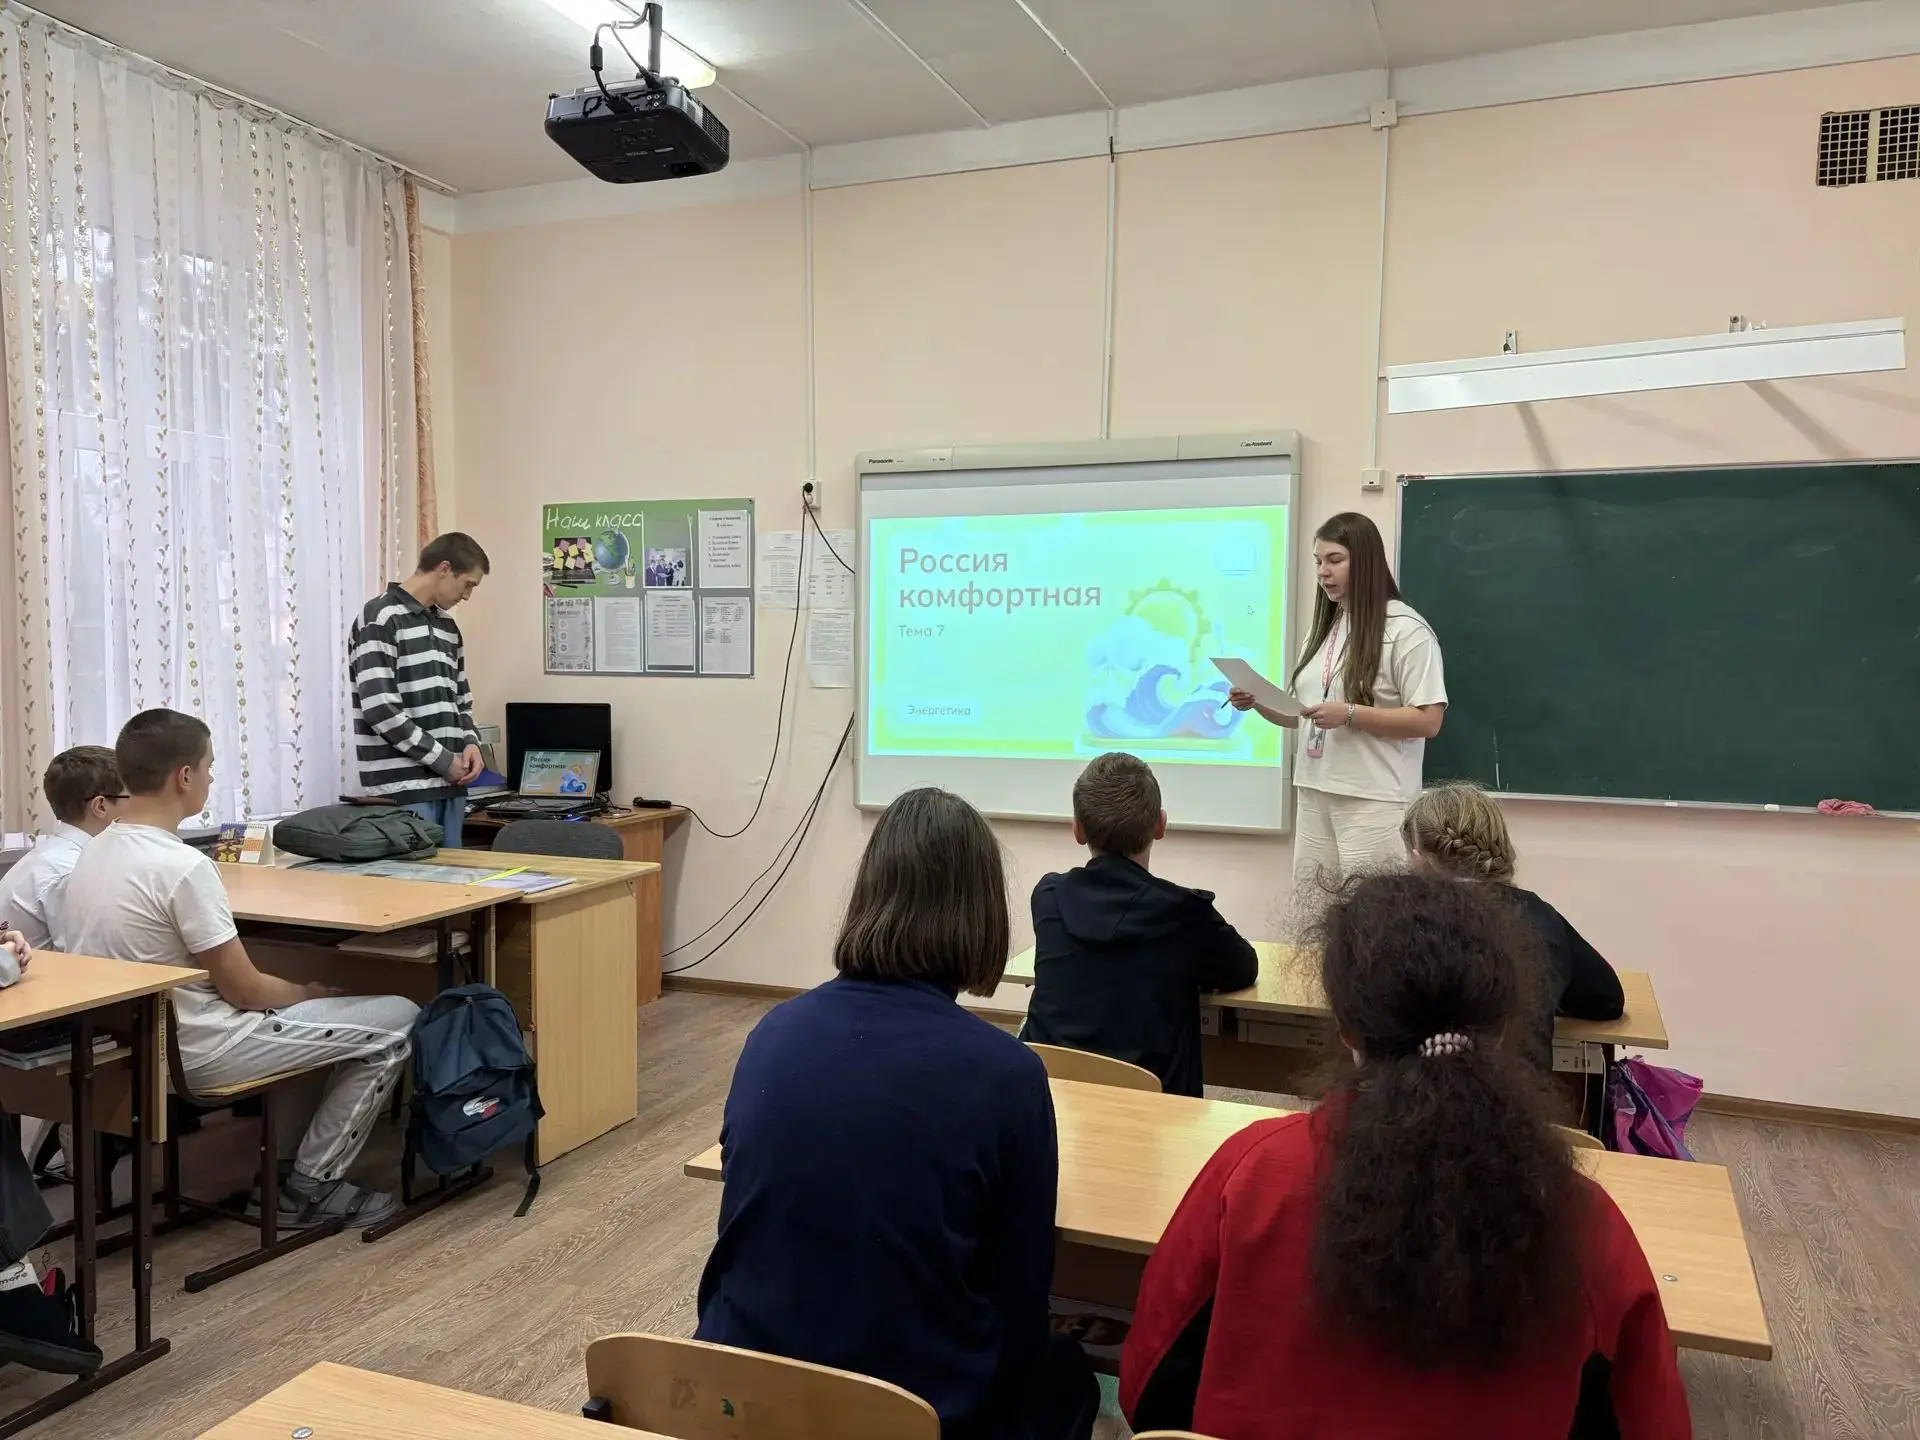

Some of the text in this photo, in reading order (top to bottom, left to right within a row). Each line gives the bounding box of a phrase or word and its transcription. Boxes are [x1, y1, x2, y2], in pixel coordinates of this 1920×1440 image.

[546, 507, 642, 531] Наш класс
[900, 548, 1008, 573] Россия
[900, 580, 1101, 614] комфортная
[898, 624, 945, 638] Тема 7
[907, 704, 971, 717] Энергетика
